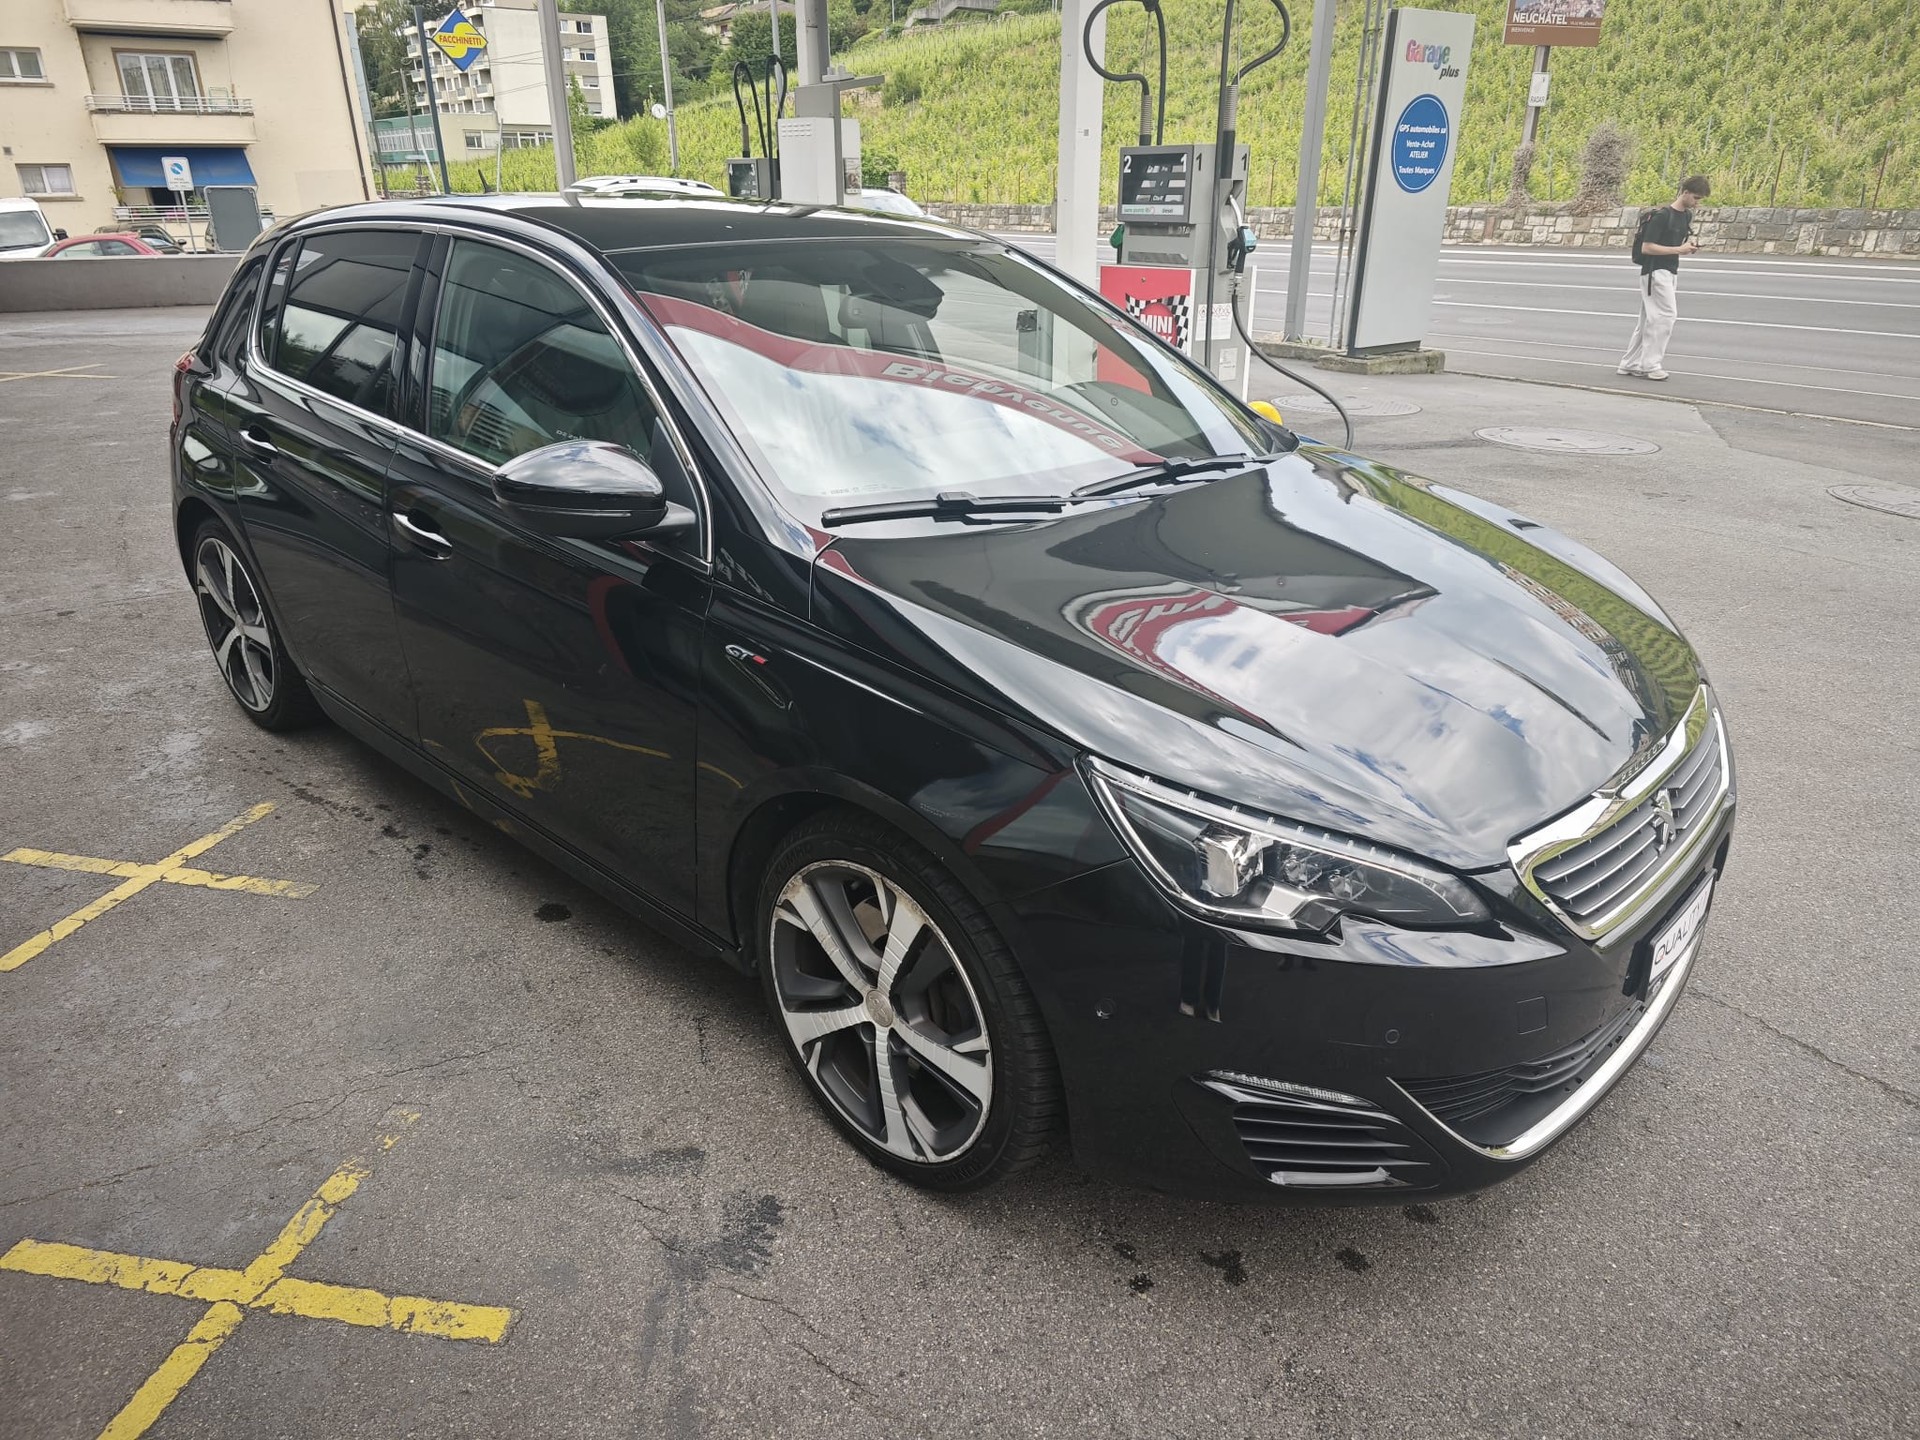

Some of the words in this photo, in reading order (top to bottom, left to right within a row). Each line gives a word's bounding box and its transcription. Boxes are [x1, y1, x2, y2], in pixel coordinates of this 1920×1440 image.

[1513, 8, 1568, 25] NEUCHÂTEL
[439, 35, 482, 46] FACCHINETTI
[1406, 39, 1450, 70] Garage
[1439, 65, 1460, 80] plus
[1399, 124, 1410, 132] GPS
[1410, 125, 1440, 134] automobiles
[1406, 140, 1435, 148] Vente-Achat
[1123, 155, 1132, 173] 2
[1180, 153, 1187, 172] 1
[1196, 153, 1202, 171] 1
[1241, 153, 1247, 171] 1
[1399, 166, 1414, 174] Toutes
[1414, 166, 1435, 175] Marques
[1140, 314, 1172, 334] MINI
